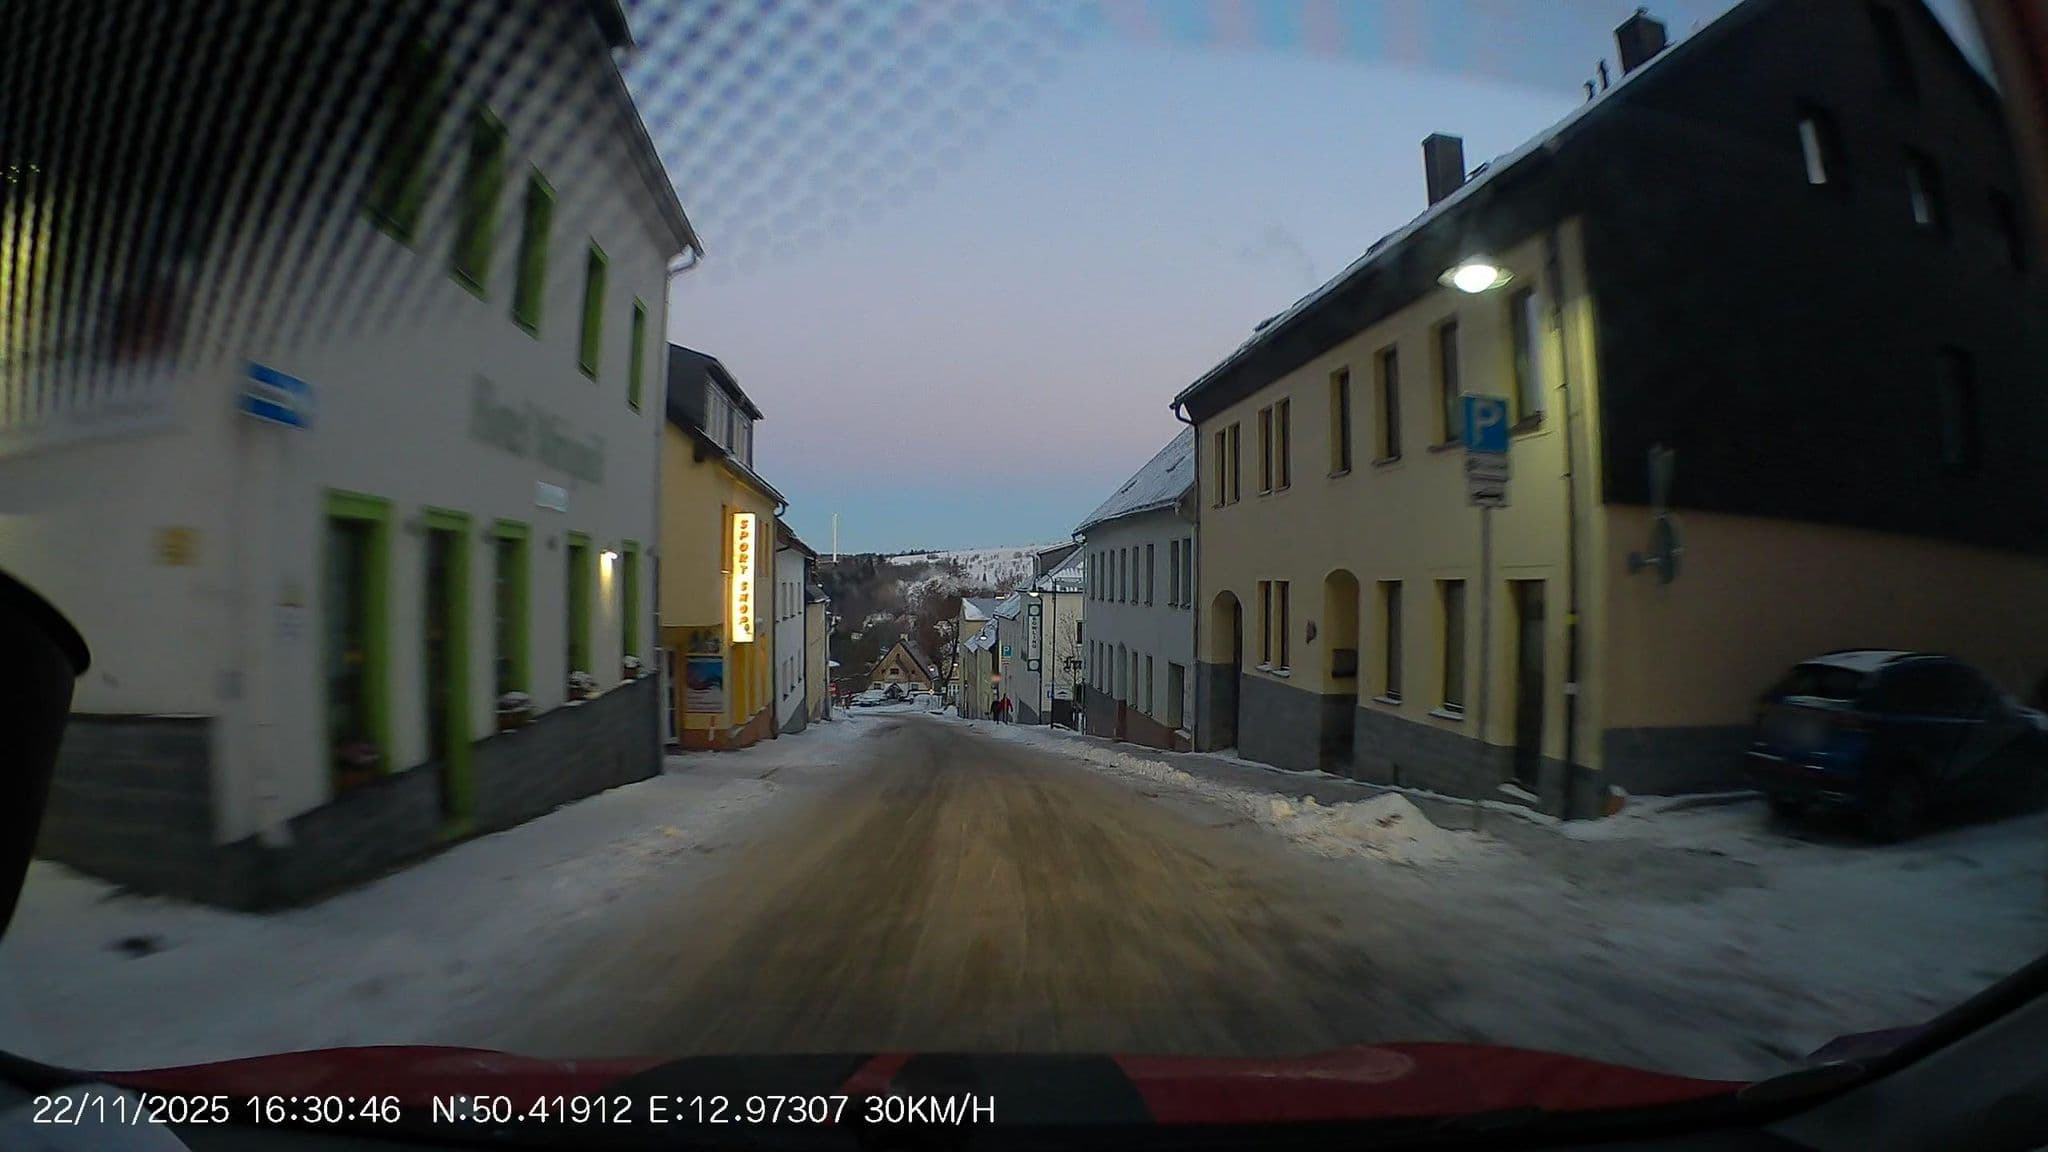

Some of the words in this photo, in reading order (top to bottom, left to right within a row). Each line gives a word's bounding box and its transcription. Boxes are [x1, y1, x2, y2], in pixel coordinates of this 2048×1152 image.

[1472, 400, 1502, 446] P
[739, 519, 749, 574] SPORT
[739, 581, 749, 625] SHOP
